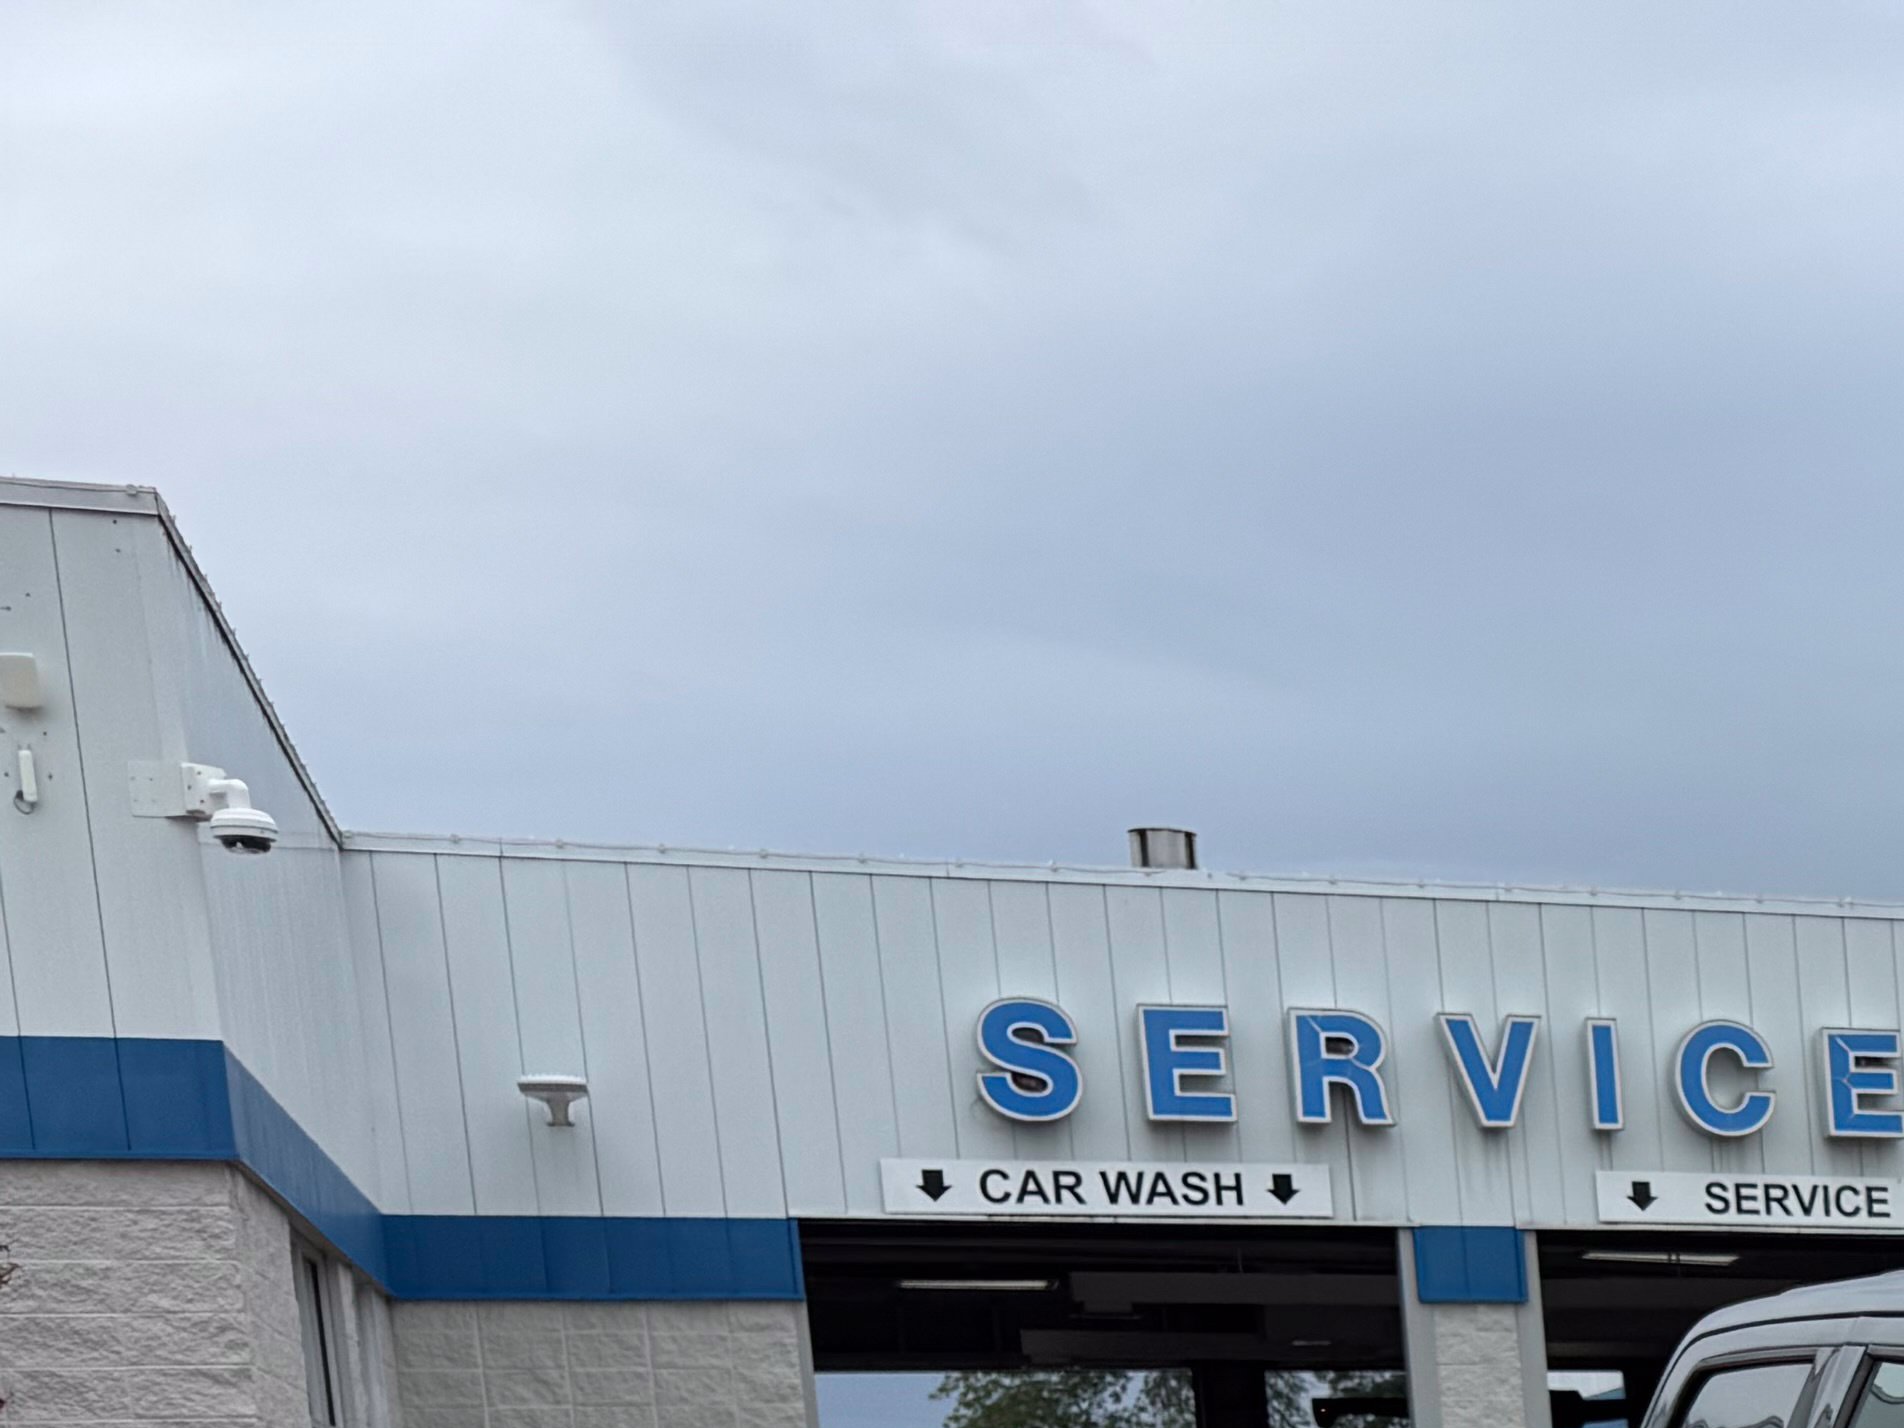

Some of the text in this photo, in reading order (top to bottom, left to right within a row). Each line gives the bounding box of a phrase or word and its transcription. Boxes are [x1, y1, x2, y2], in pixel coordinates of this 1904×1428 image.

[980, 1168, 1243, 1206] CAR WASH
[1705, 1181, 1891, 1218] SERVICE
